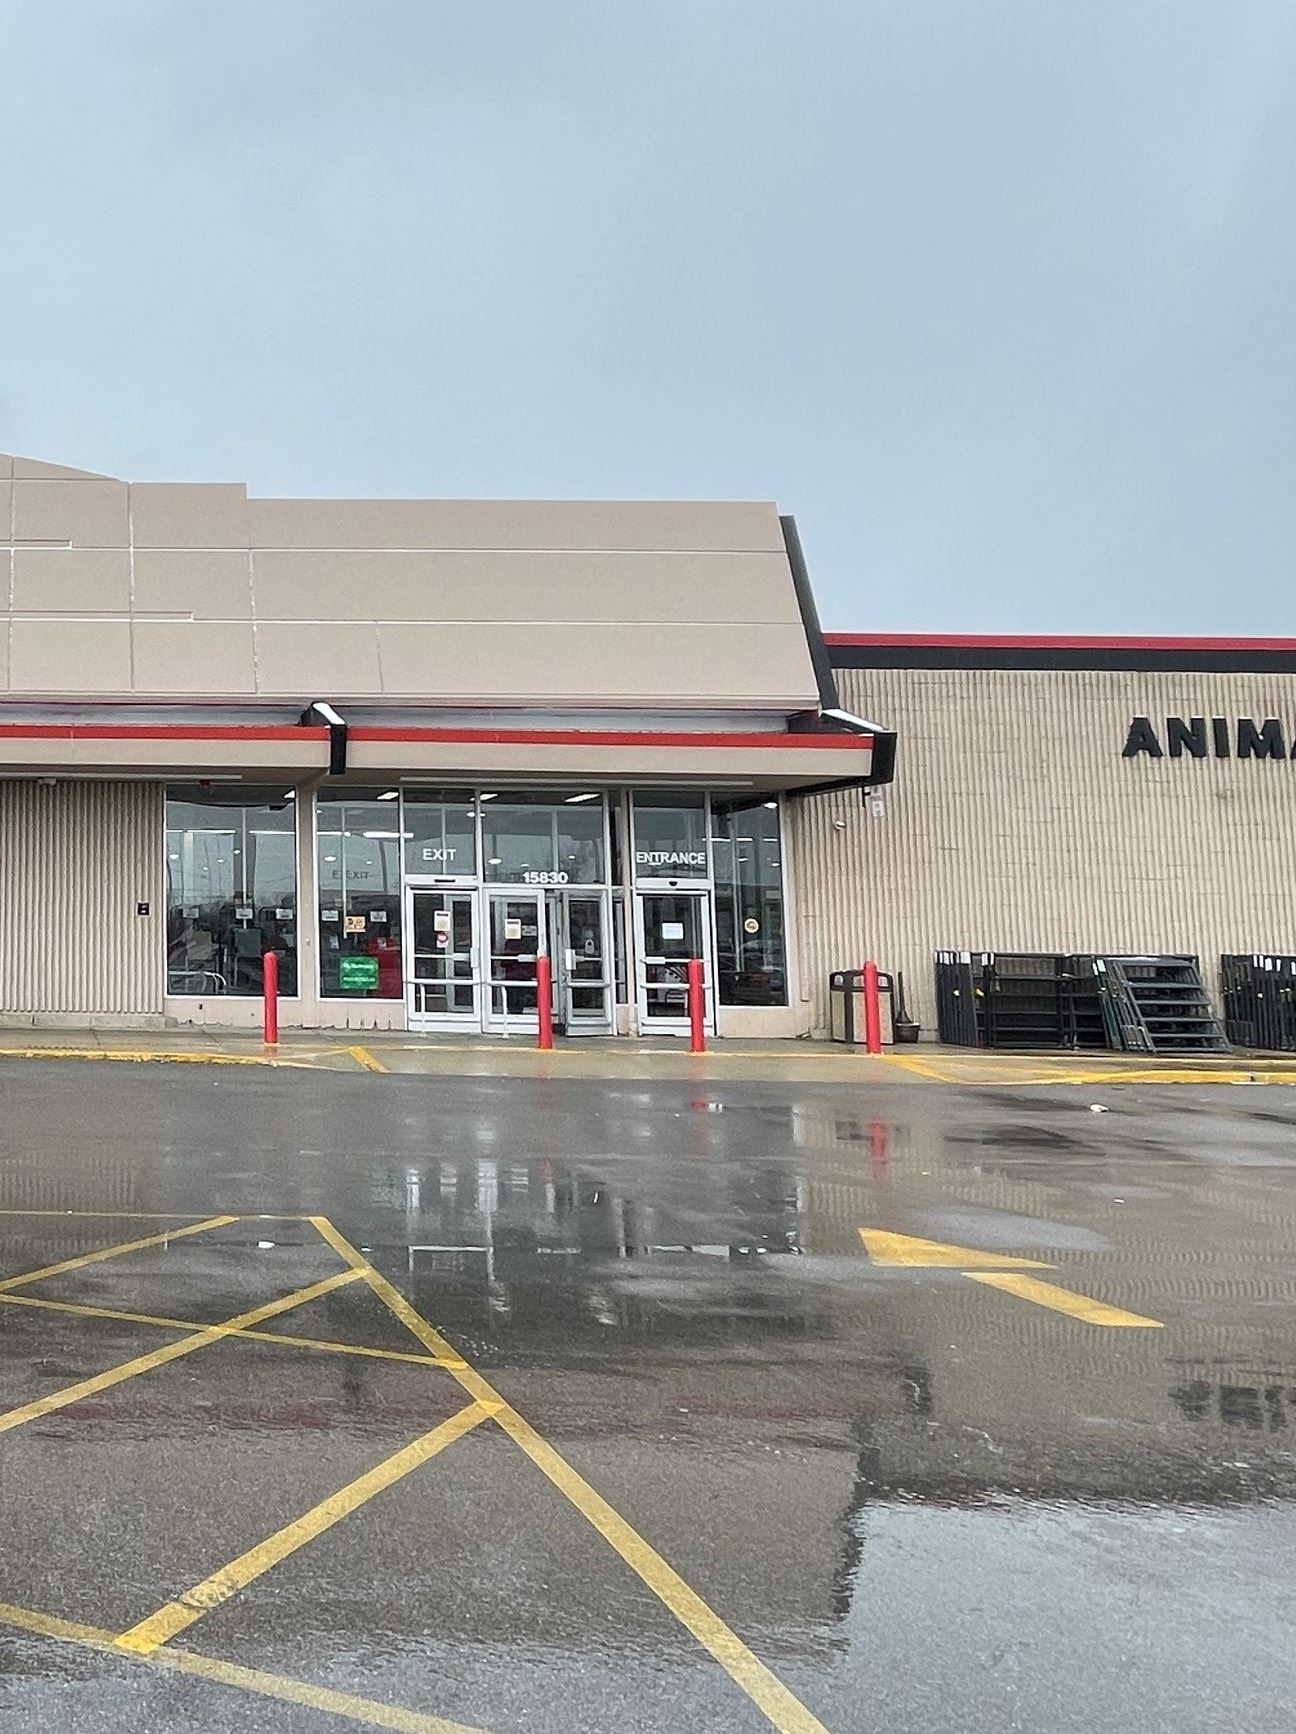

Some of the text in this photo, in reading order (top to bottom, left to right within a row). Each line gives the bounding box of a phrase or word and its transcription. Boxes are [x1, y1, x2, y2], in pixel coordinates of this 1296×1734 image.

[1122, 715, 1296, 759] ANIM
[422, 848, 457, 861] EXIT
[636, 851, 706, 865] ENTRANCE
[522, 871, 569, 884] 15830
